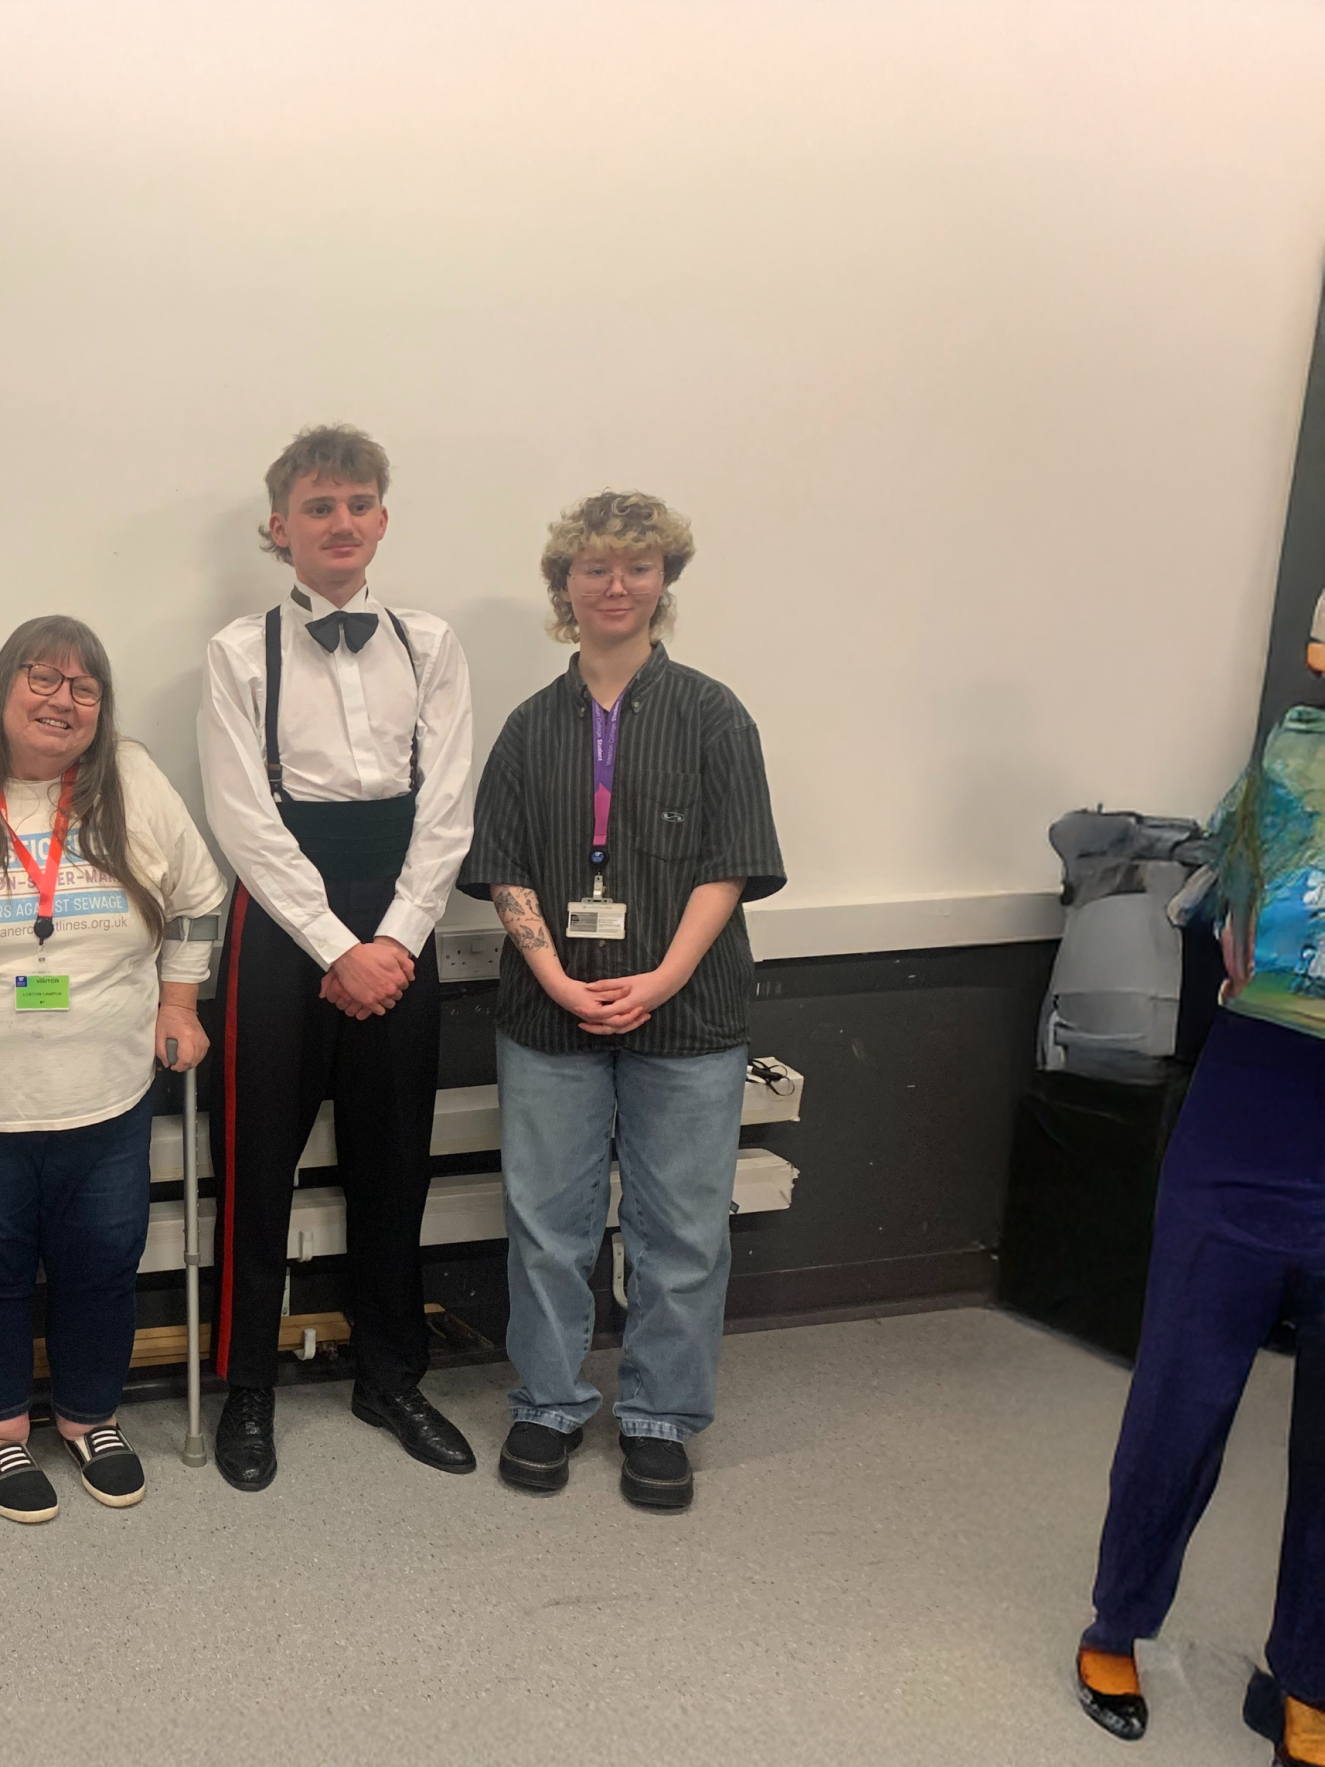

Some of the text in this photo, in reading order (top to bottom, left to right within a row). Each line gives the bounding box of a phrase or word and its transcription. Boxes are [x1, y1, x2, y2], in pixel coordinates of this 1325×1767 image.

[609, 722, 617, 744] College
[606, 744, 614, 766] Weston
[16, 898, 70, 917] AGAST
[74, 895, 124, 911] SEWAGE
